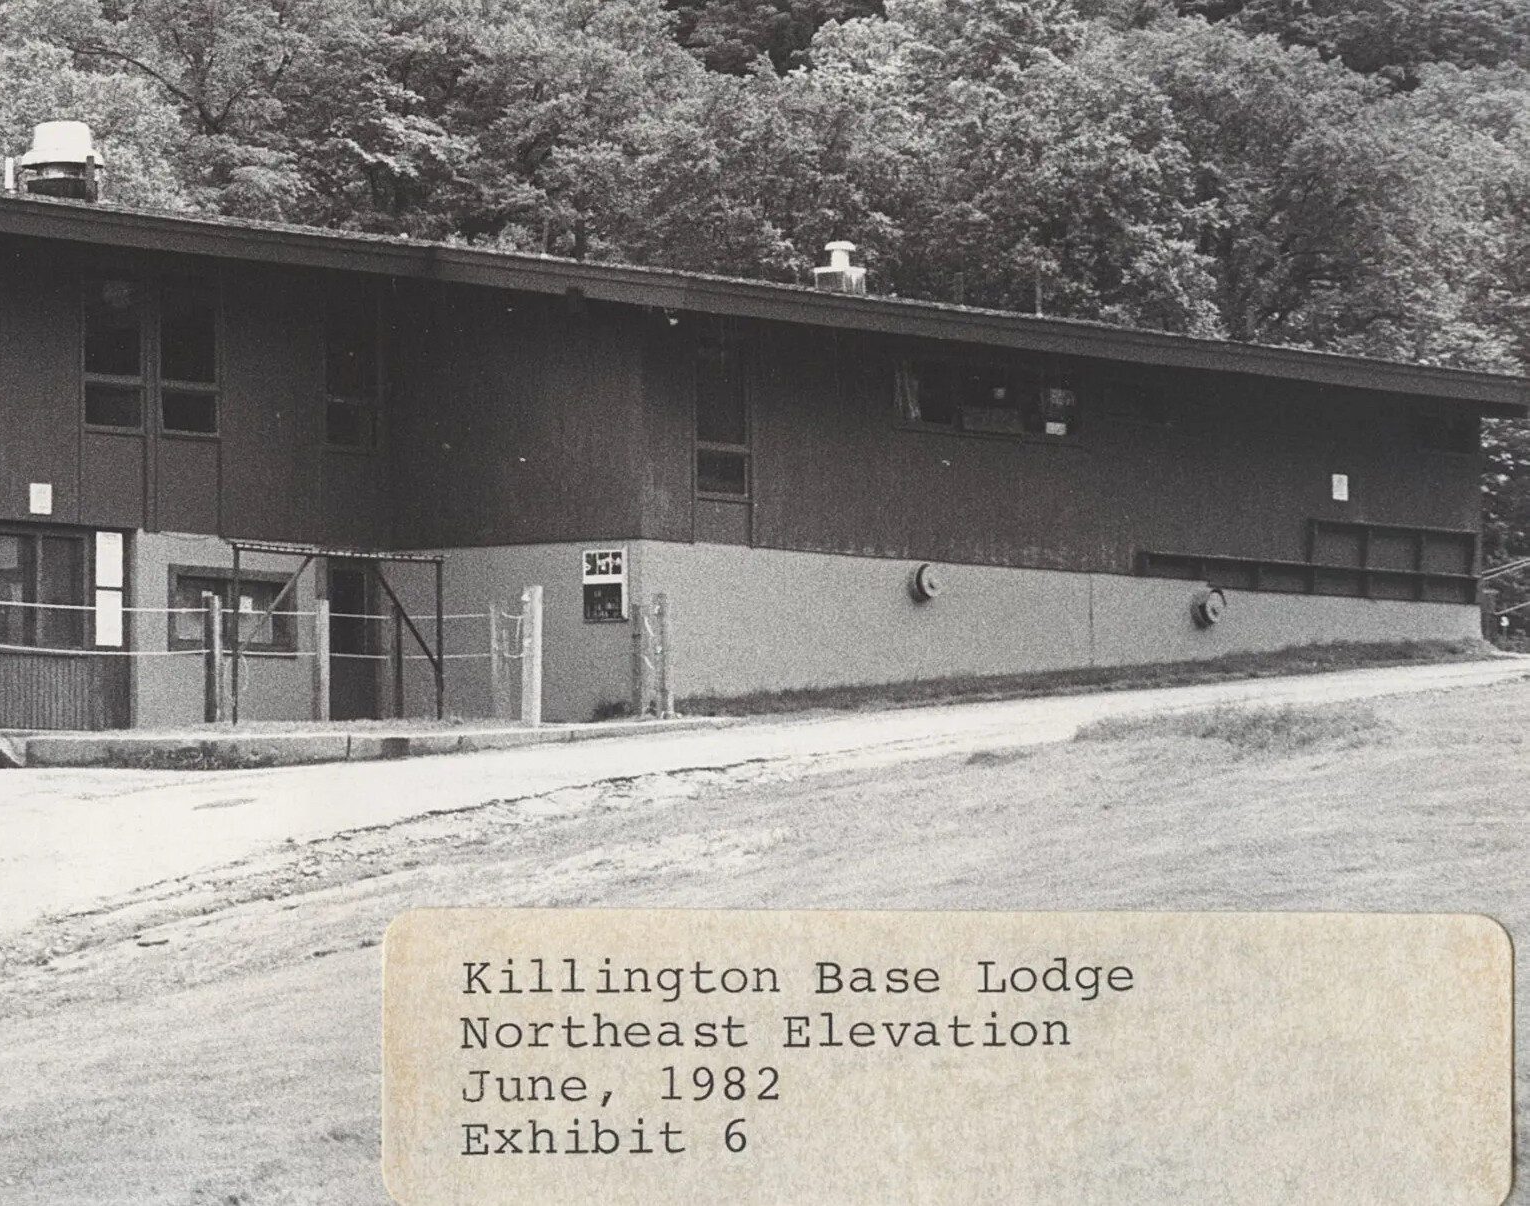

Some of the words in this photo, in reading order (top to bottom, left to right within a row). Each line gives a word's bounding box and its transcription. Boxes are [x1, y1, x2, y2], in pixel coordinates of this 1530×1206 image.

[462, 957, 781, 1003] Killington
[814, 961, 941, 995] Base
[976, 956, 1134, 1002] Lodge
[459, 1013, 749, 1049] Northeast
[782, 1011, 1072, 1049] Elevation
[461, 1069, 613, 1107] June,
[660, 1066, 781, 1102] 1982
[460, 1117, 687, 1156] Exhibit
[724, 1118, 749, 1154] 6
